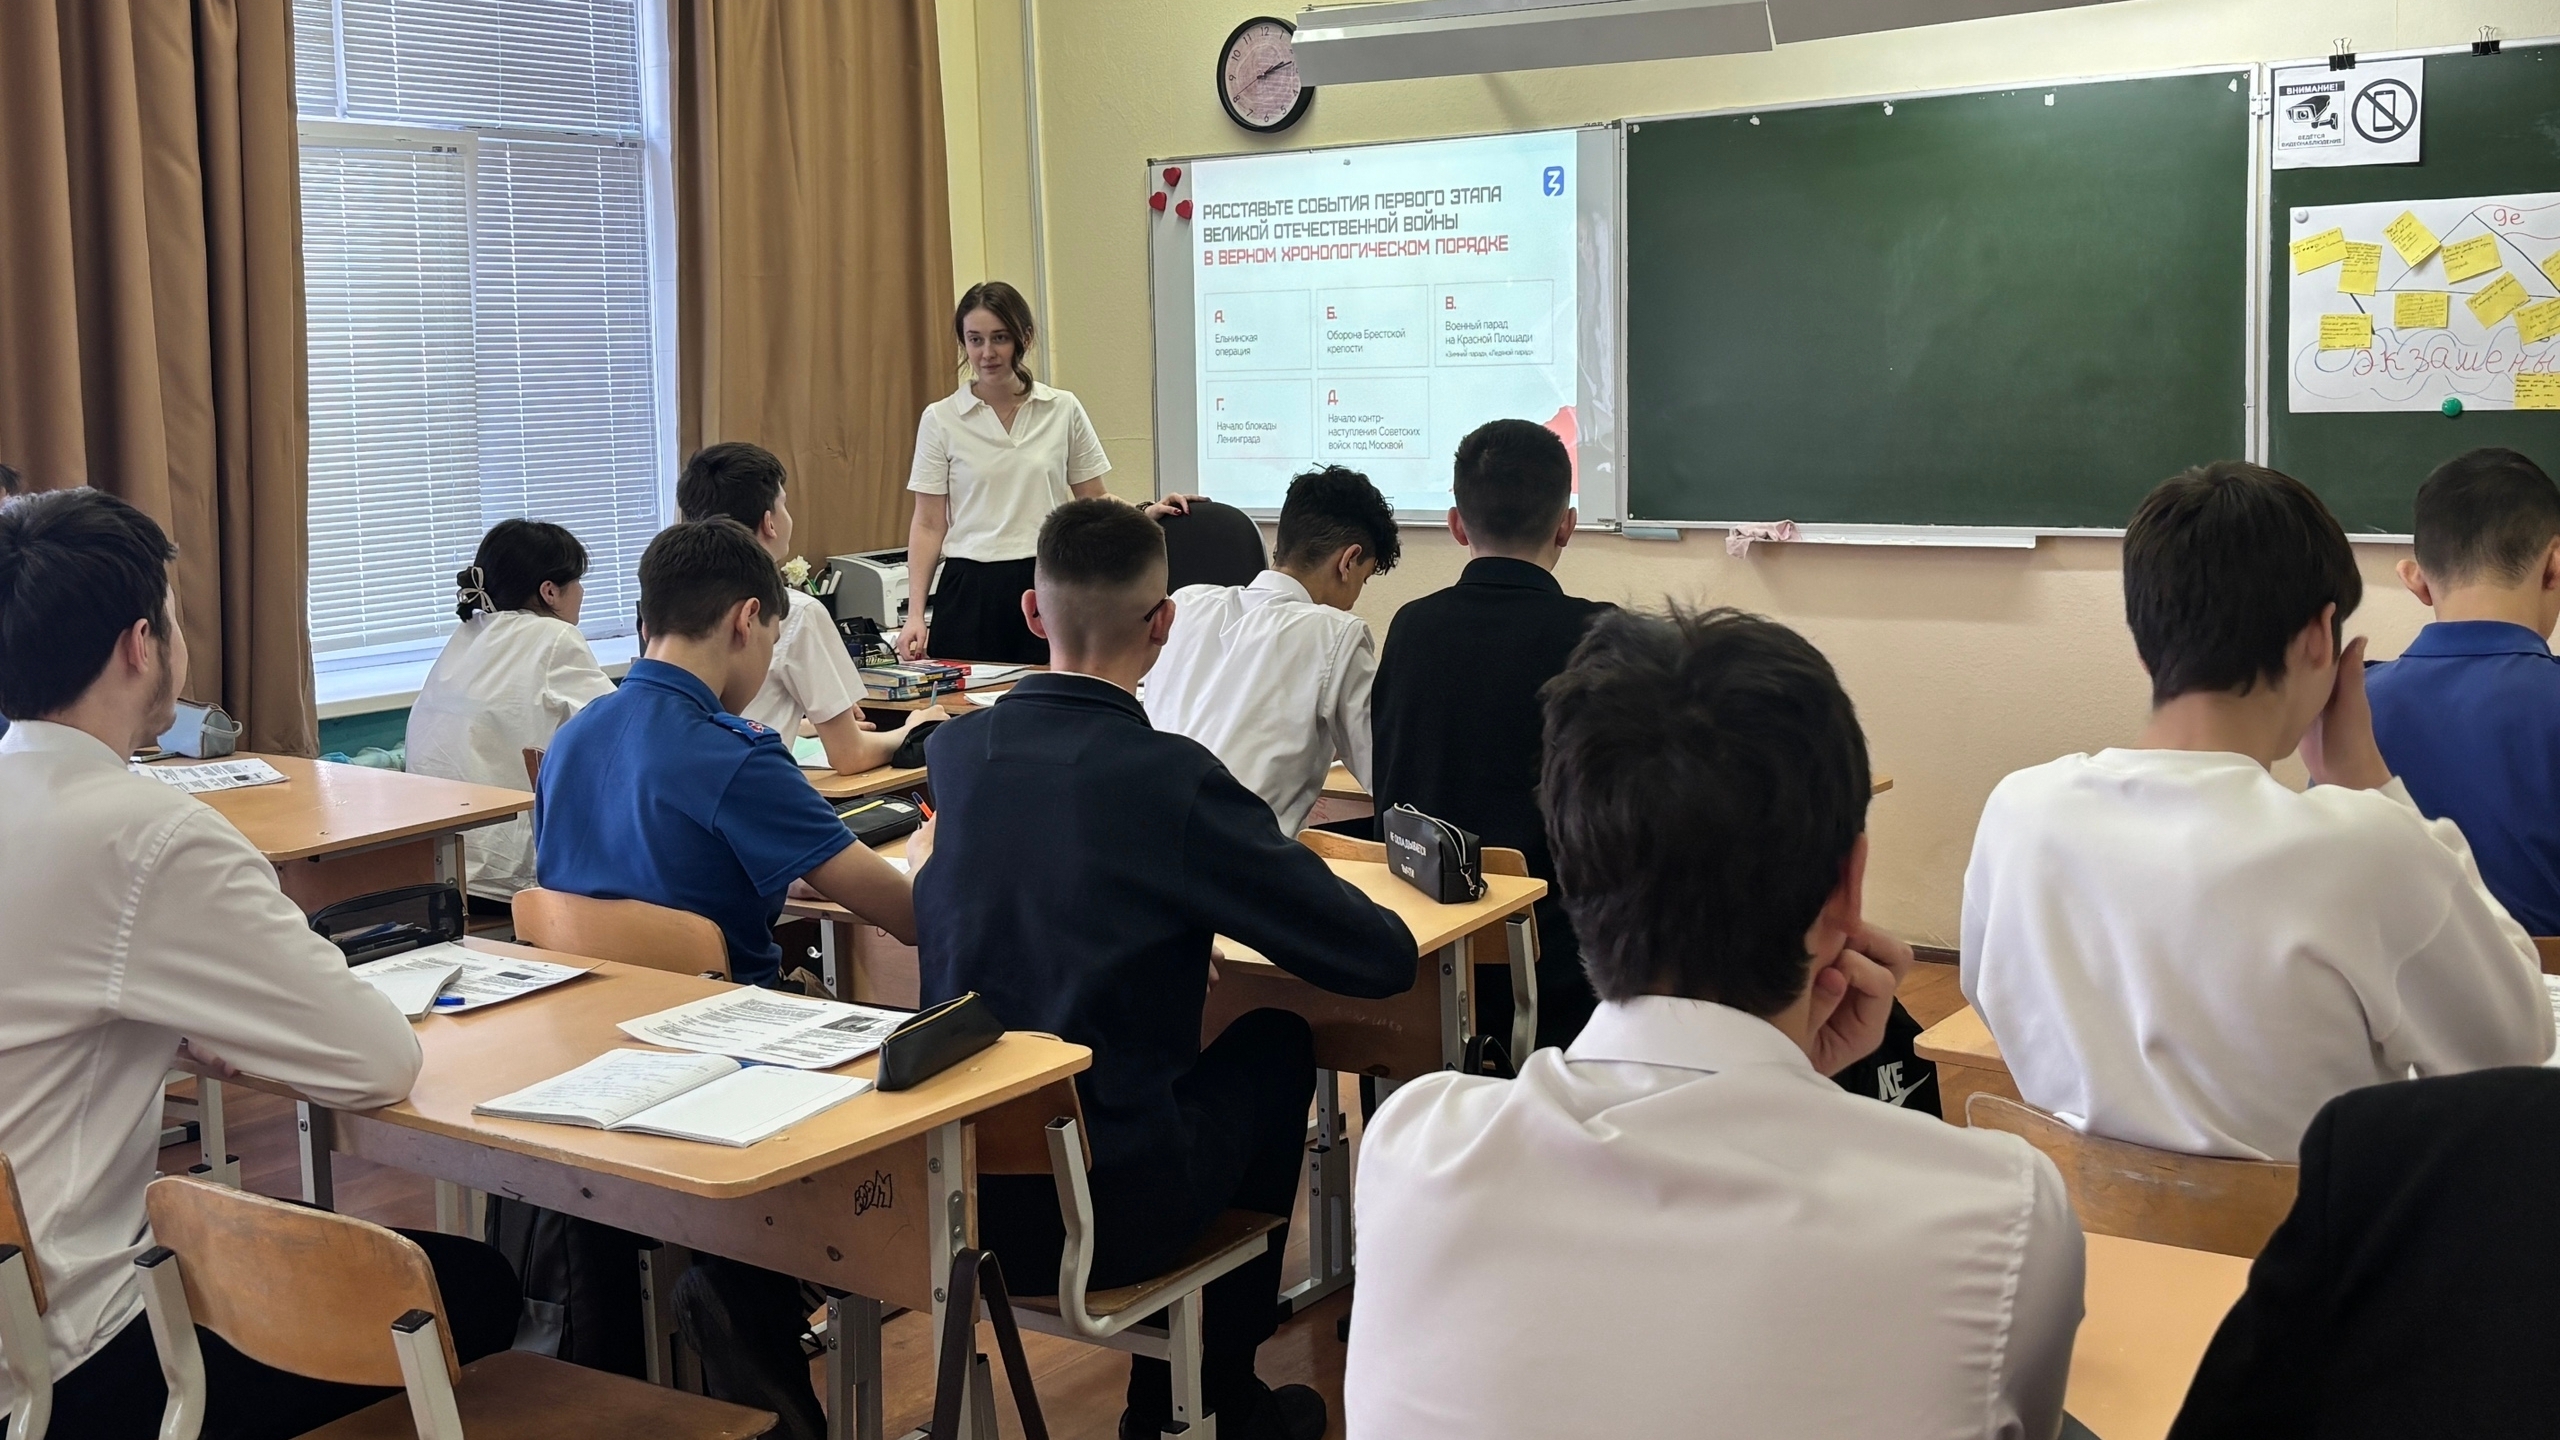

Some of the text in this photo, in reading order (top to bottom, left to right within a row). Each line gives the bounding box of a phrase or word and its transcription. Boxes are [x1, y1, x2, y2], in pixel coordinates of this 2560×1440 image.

[1260, 26, 1270, 37] 12
[1243, 33, 1252, 45] 11
[1232, 50, 1241, 60] 10
[2286, 83, 2338, 95] ВНИМАНИЕ!
[1233, 95, 1240, 103] 8
[1246, 108, 1254, 117] 7
[1280, 105, 1287, 116] 5
[1263, 114, 1270, 123] 6
[1203, 185, 1502, 220] РАССТАВЬТЕ СОБЫТИЯ ПЕРВОГО ЭТАПА
[1203, 208, 1459, 243] ВЕЛИКОЙ ОТЕЧЕСТВЕННОЙ ВОЙНЫ
[1204, 234, 1509, 266] В ВЕРНОМ ХРОНОЛОГИЧЕСКОМ ПОРЯДКЕ
[1445, 296, 1456, 310] В.
[1445, 320, 1509, 331] Военный парад
[1215, 333, 1258, 344] Ельнинская
[1327, 328, 1406, 342] Оборона Брестской
[1445, 332, 1534, 347] на Красной Площади
[1215, 347, 1251, 358] операция
[1327, 343, 1364, 354] крепости
[1216, 398, 1225, 411] Г.
[1328, 413, 1384, 424] Начало контр-
[1216, 420, 1277, 432] Начало блокады
[1328, 426, 1421, 438] наступления Советских
[1216, 434, 1261, 445] Ленинграда
[1328, 439, 1404, 451] войск под Москвой
